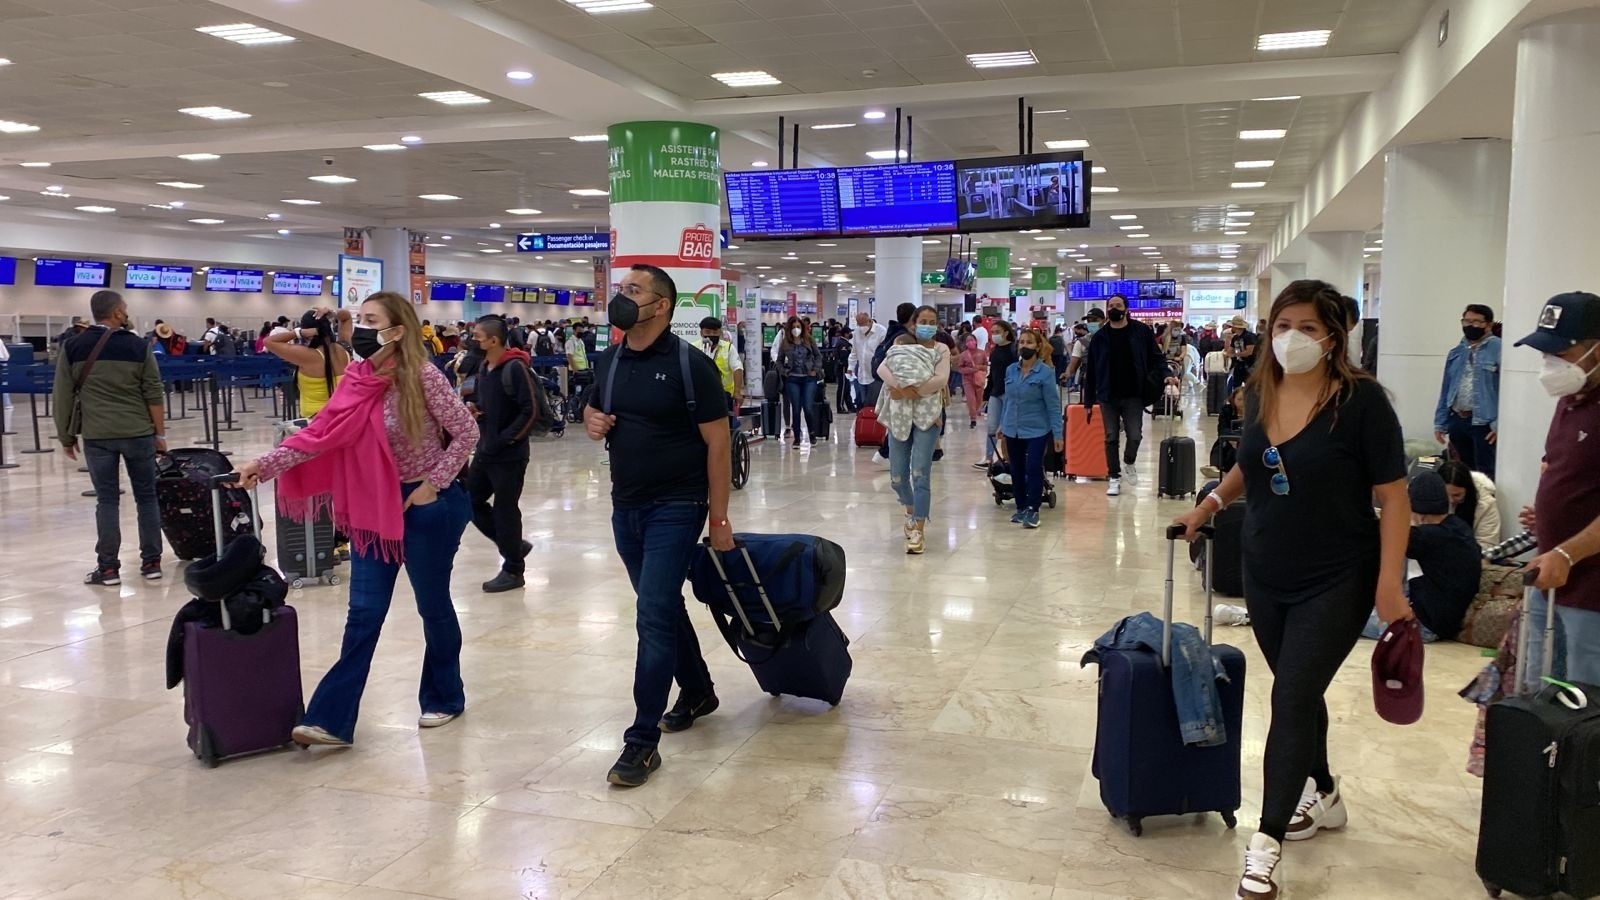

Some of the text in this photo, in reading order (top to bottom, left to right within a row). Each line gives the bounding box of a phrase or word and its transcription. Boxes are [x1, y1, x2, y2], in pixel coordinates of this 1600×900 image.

[661, 144, 706, 156] ASISTENTE
[671, 157, 709, 168] RASTREO
[653, 169, 697, 179] MALETAS
[547, 235, 572, 243] Passenger
[685, 232, 712, 242] PROTEC
[584, 242, 608, 250] pasajeros
[682, 241, 712, 258] BAG
[1166, 310, 1183, 318] STOR
